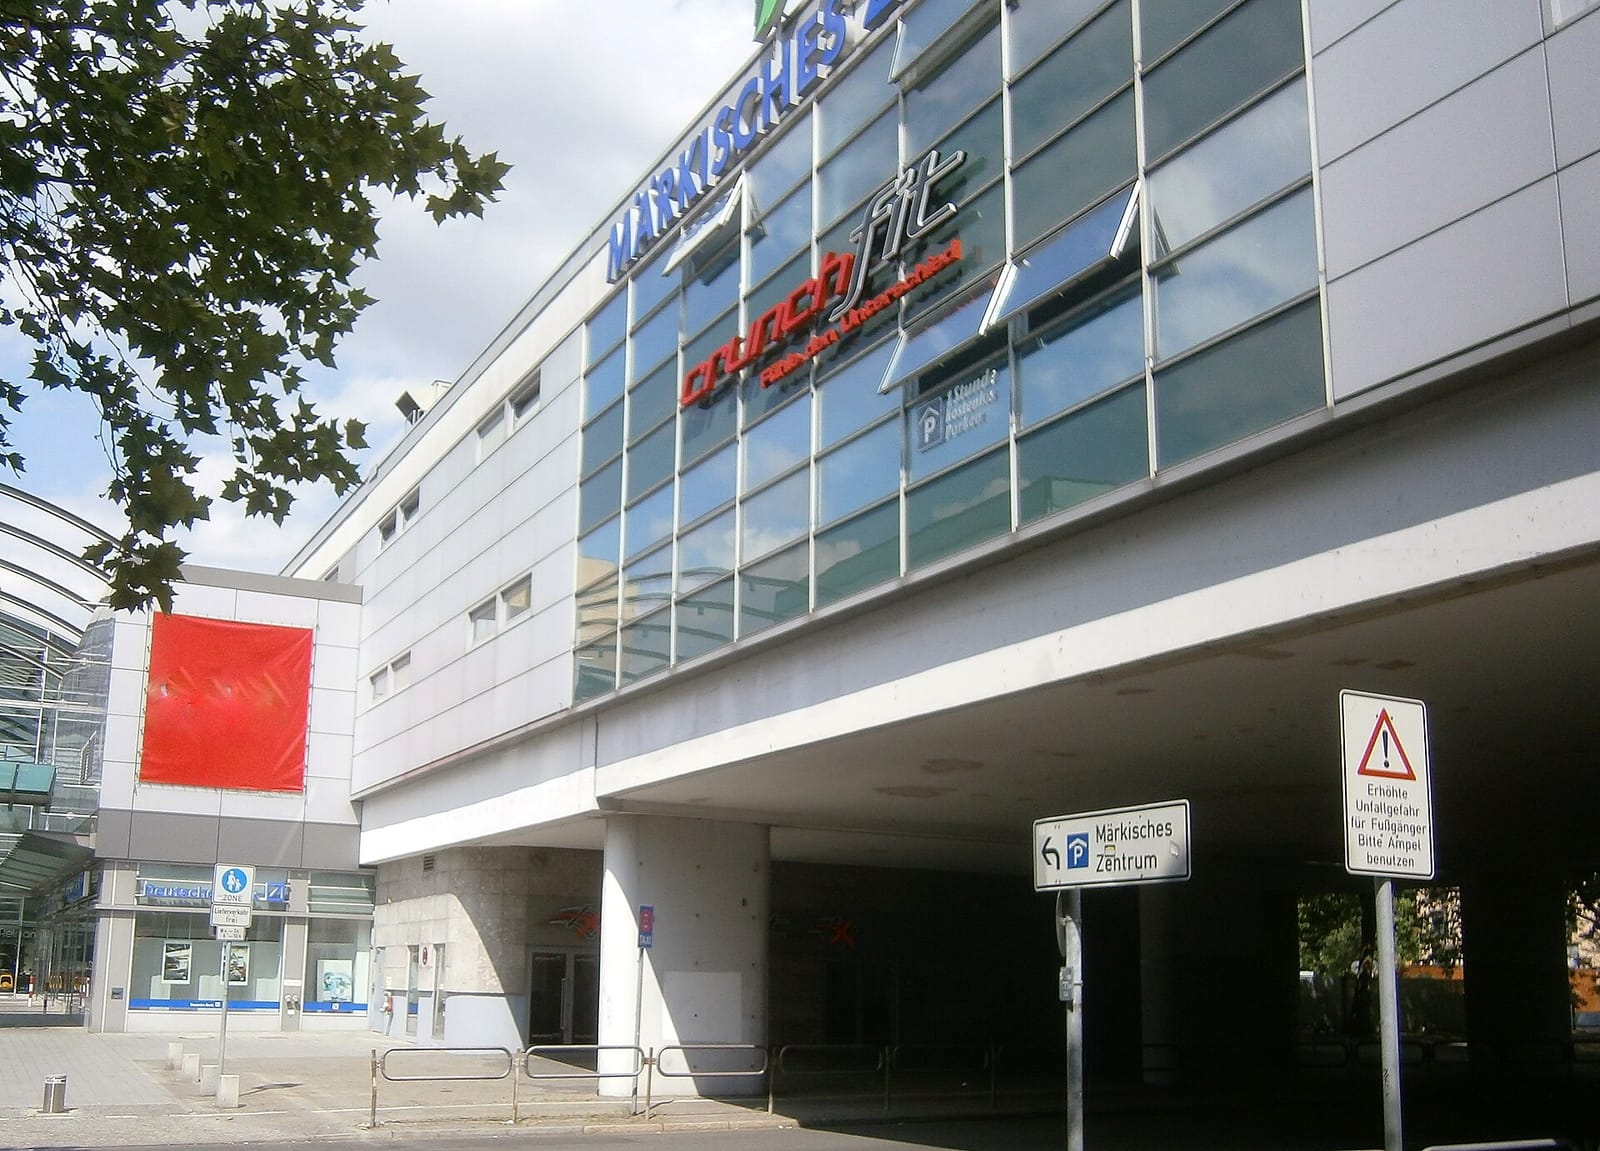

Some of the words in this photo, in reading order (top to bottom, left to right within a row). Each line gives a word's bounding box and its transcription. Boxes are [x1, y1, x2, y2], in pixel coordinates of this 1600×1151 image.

[606, 0, 848, 284] MÄRKISCHES
[1367, 783, 1408, 800] Erhöhte
[1355, 799, 1420, 818] Unfallgefahr
[1096, 818, 1173, 844] Märkisches
[1351, 815, 1366, 830] für
[1371, 818, 1427, 836] Fußgänger
[1358, 833, 1383, 847] Bitte
[1388, 836, 1421, 853] Ampel
[1073, 847, 1083, 866] P
[1096, 852, 1158, 873] Zentrum
[1367, 852, 1415, 868] benutzen
[222, 894, 243, 902] ZONE
[225, 916, 238, 924] frei
